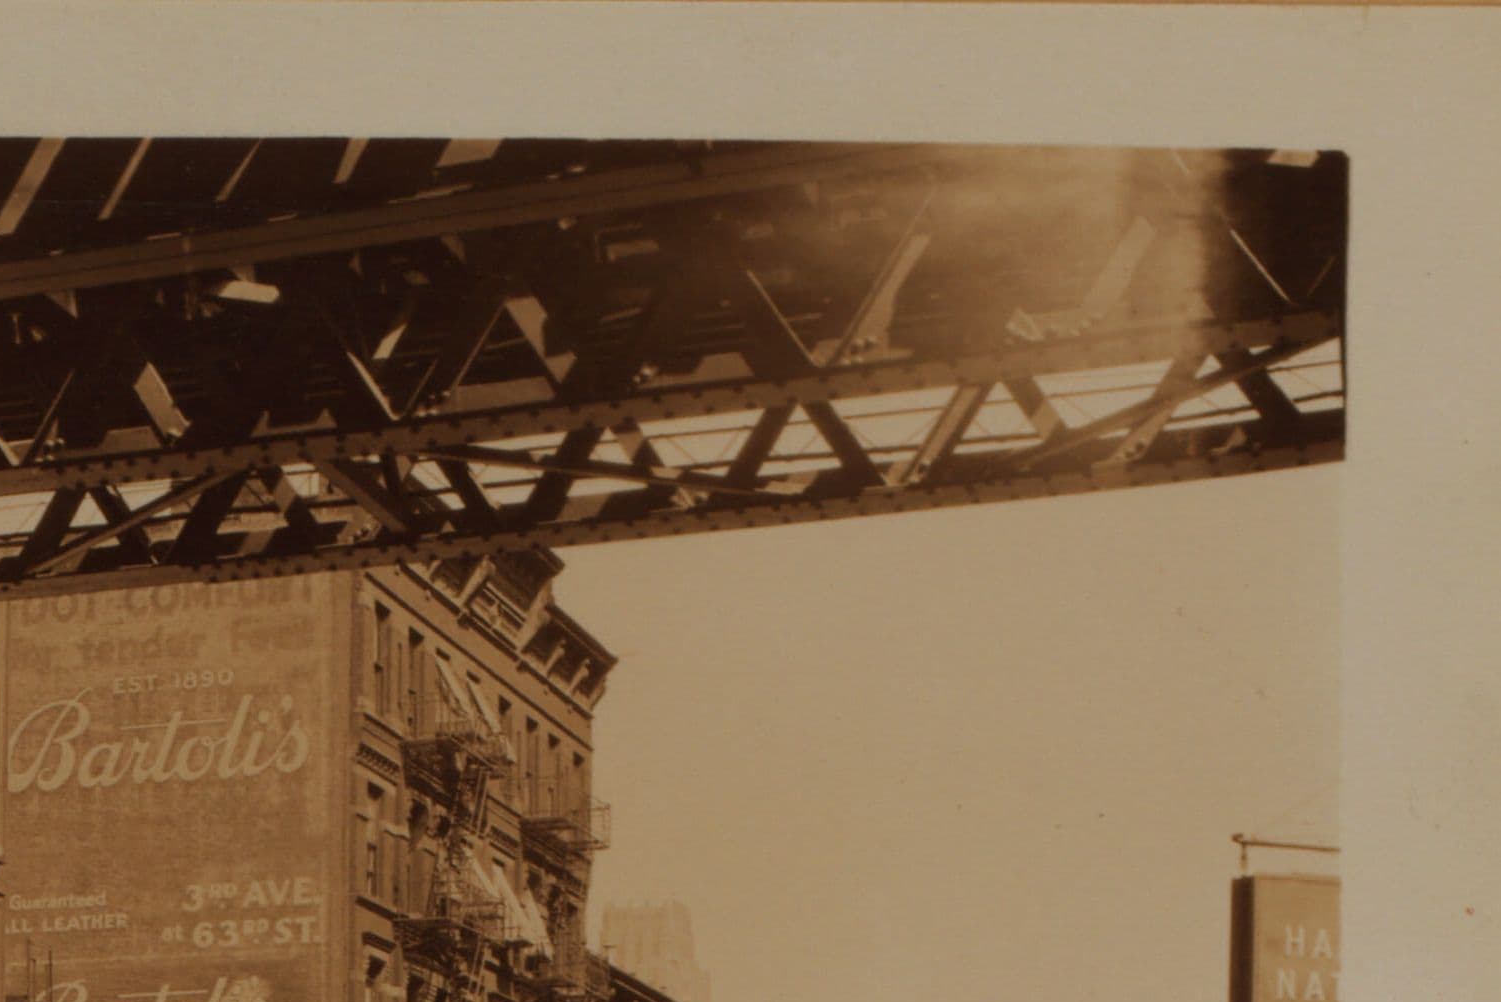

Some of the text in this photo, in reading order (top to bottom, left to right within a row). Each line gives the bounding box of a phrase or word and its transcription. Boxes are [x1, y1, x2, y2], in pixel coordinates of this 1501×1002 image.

[172, 667, 235, 690] 1890
[7, 686, 311, 793] Bartoli's
[8, 889, 107, 911] Guaranteed
[41, 911, 130, 932] LEATHER
[160, 924, 185, 943] at
